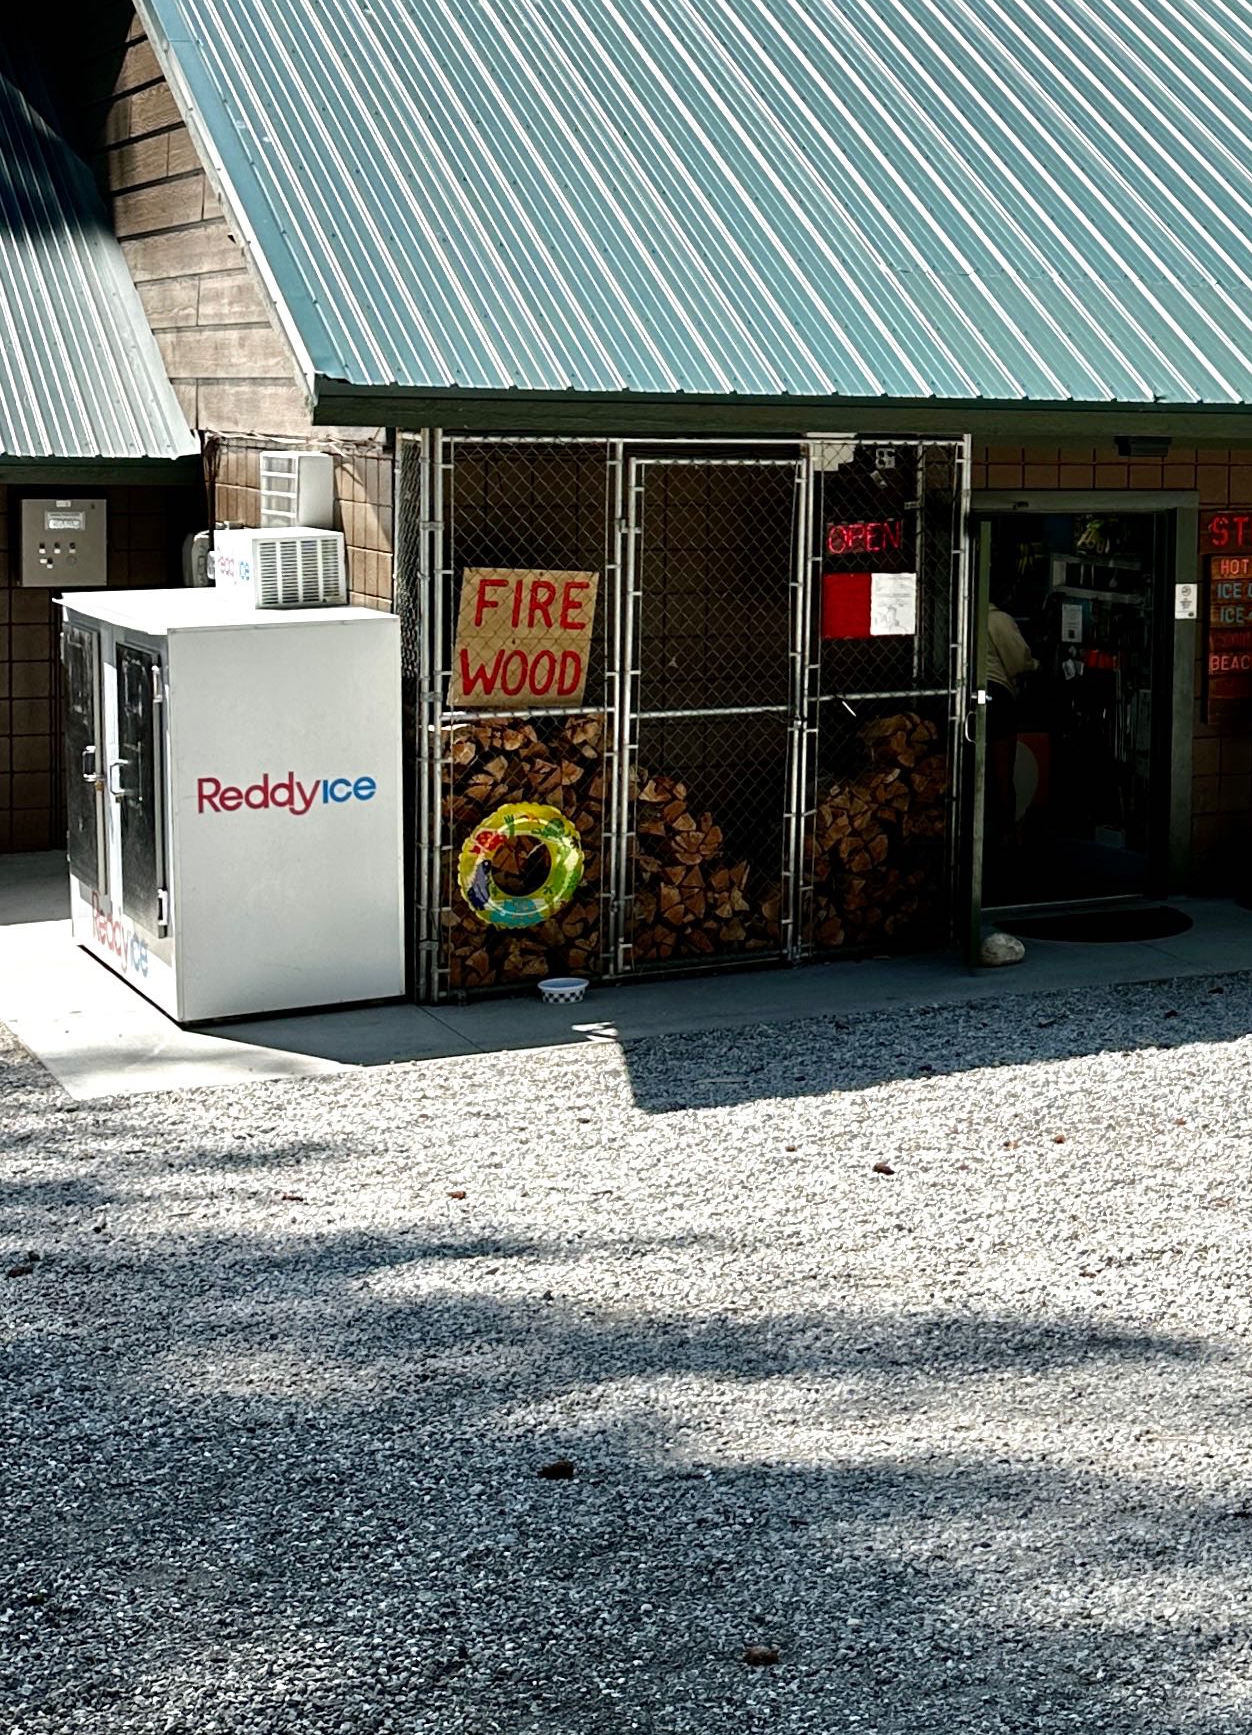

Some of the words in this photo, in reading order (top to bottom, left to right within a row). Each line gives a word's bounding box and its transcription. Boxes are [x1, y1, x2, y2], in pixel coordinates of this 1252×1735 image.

[828, 522, 900, 554] OPEN
[1220, 559, 1249, 575] HOT
[1217, 582, 1241, 599] ICE
[474, 578, 590, 630] FIRE
[1220, 606, 1245, 625] ICE
[460, 648, 582, 696] WOOD
